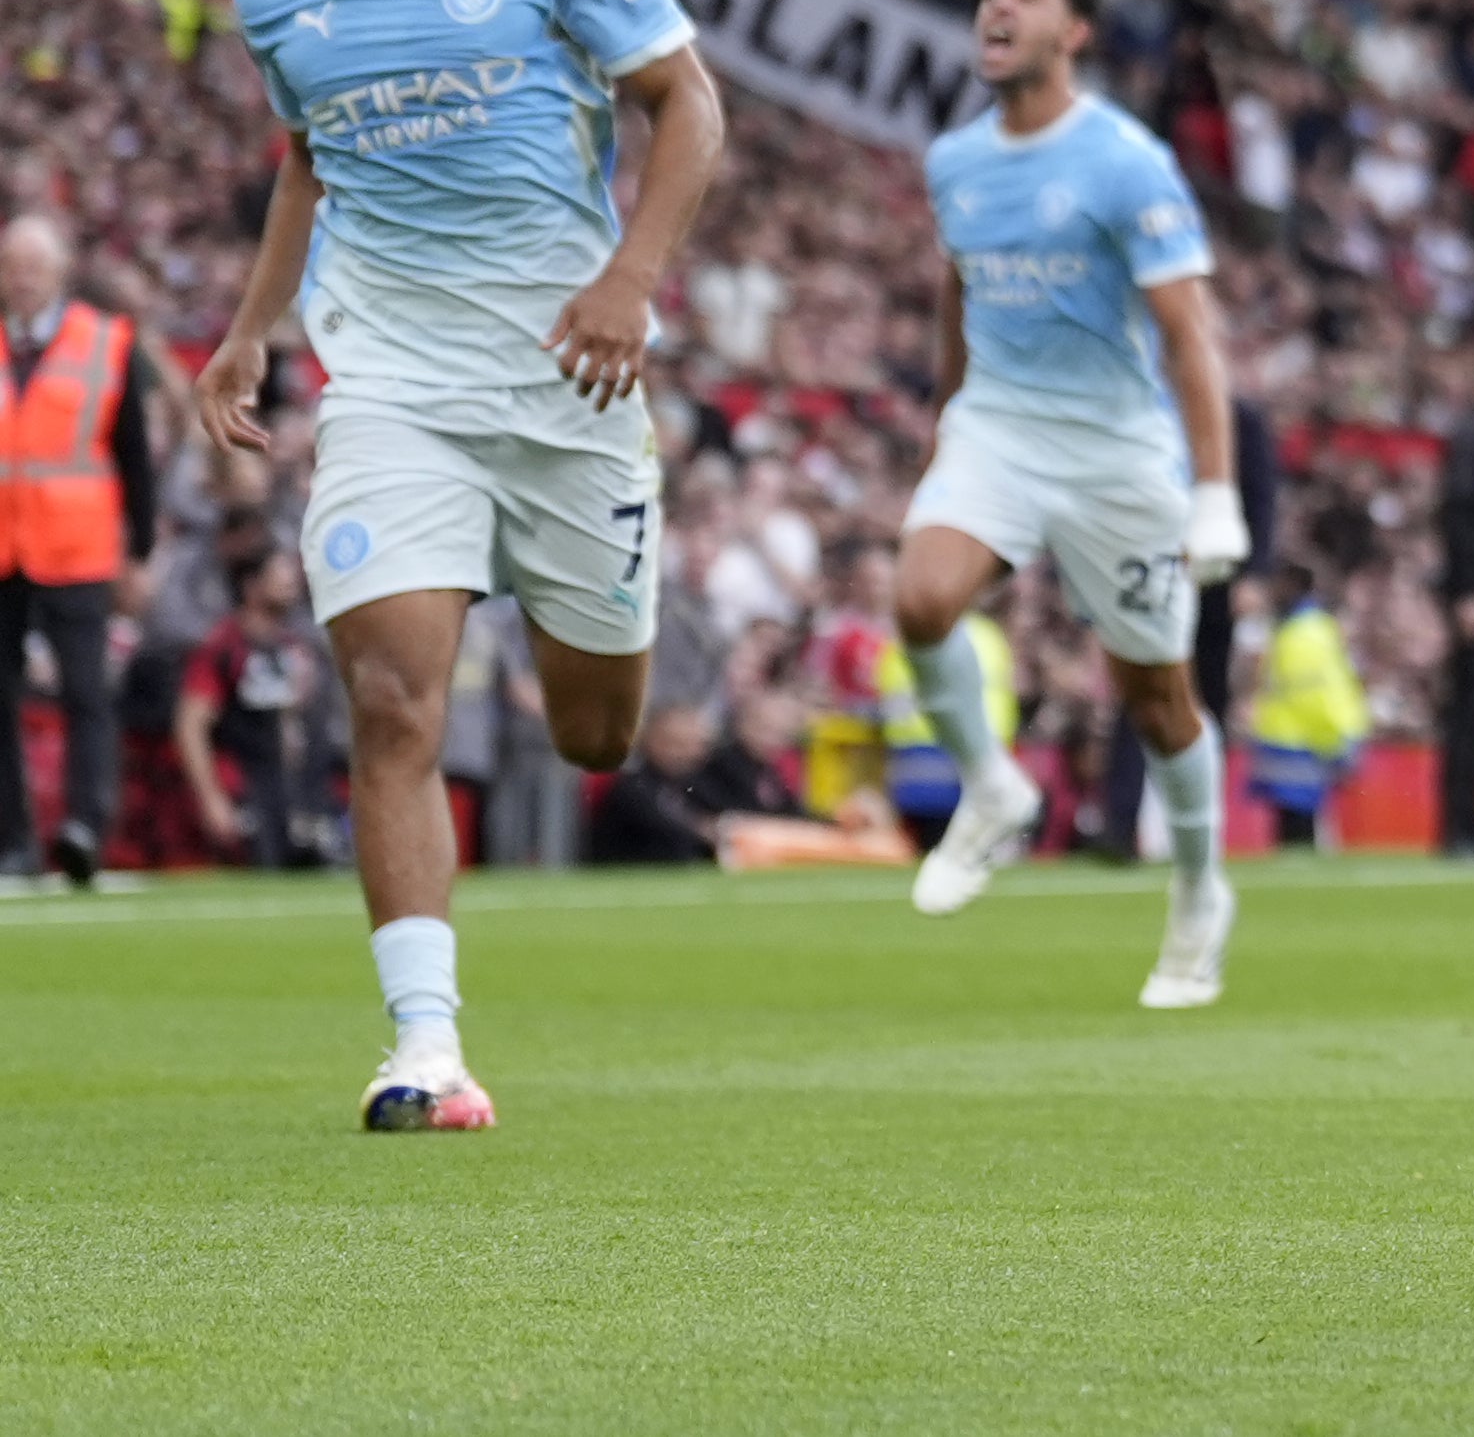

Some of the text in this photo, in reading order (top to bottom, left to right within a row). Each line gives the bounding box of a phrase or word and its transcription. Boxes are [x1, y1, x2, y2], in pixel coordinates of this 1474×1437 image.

[307, 57, 525, 134] ETIHAD
[356, 104, 489, 155] AIRWAYS
[611, 503, 645, 582] 7
